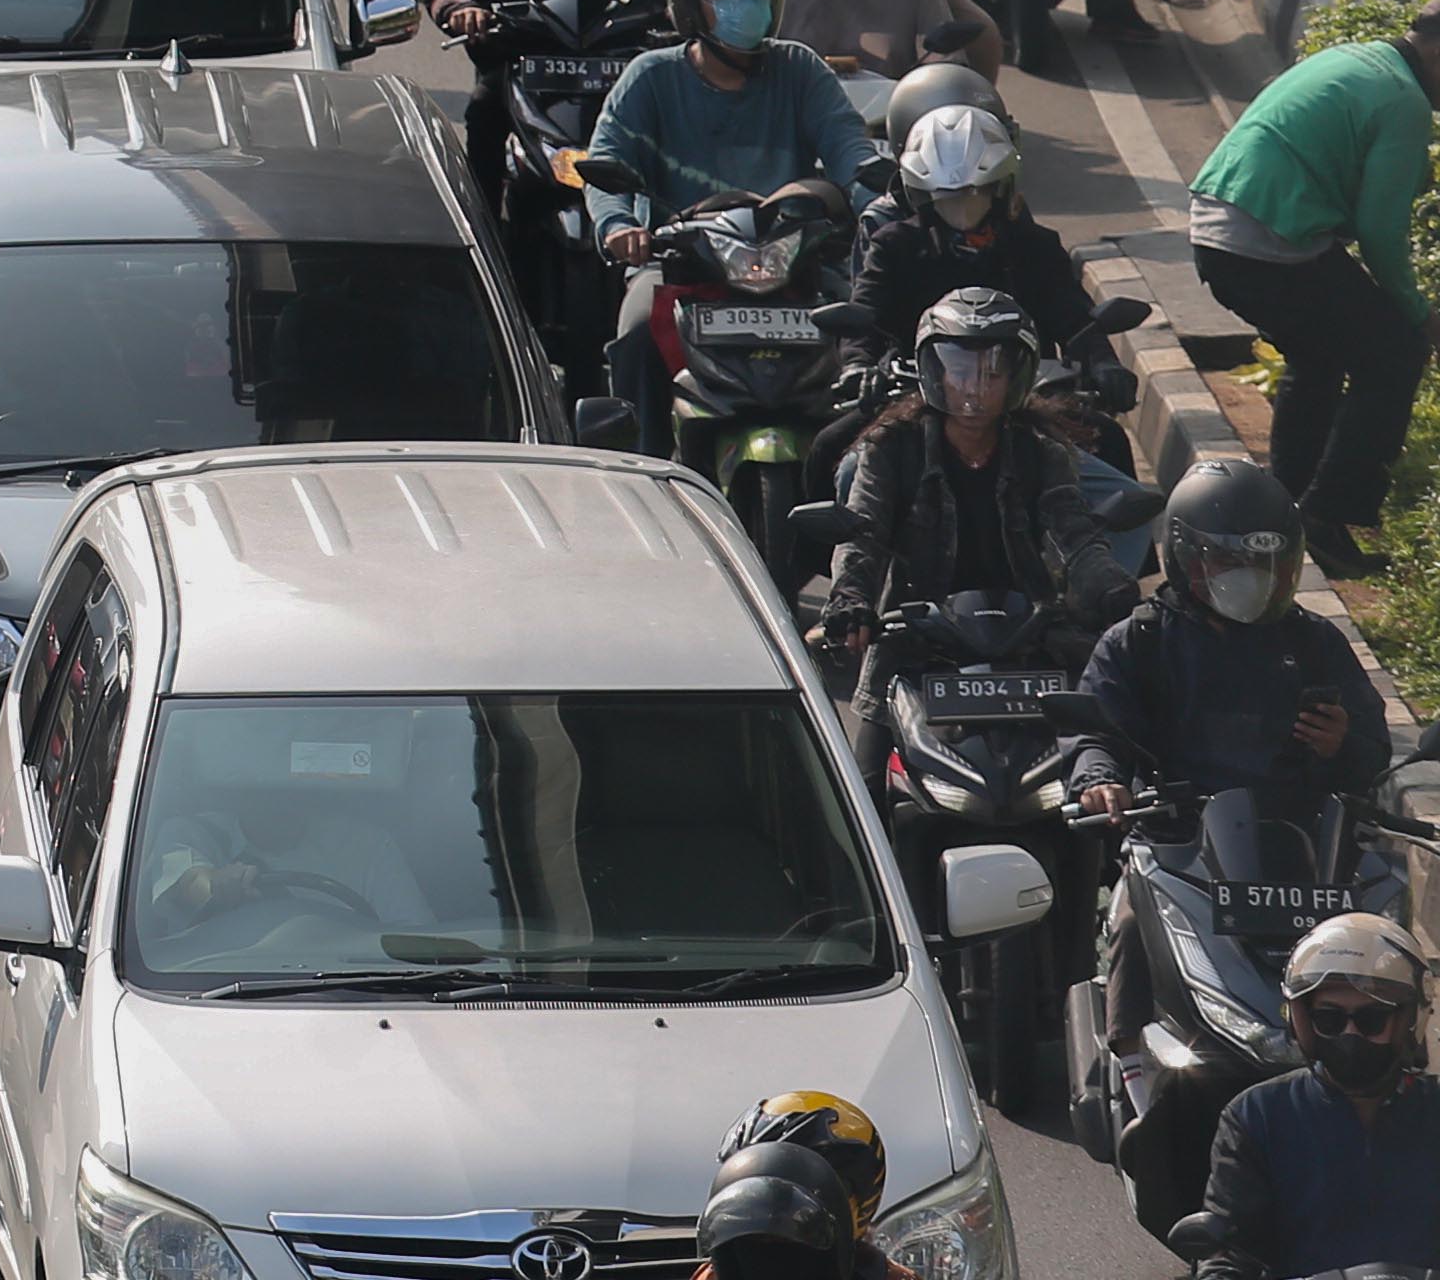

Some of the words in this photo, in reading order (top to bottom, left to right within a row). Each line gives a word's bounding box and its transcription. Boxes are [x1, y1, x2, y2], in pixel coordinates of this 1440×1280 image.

[526, 60, 536, 74] B
[546, 60, 588, 75] 3334
[703, 310, 714, 325] B
[727, 310, 772, 325] 3035
[935, 682, 946, 698] B
[958, 681, 1009, 696] 5034
[1219, 885, 1231, 905] B
[1248, 885, 1302, 907] 5710
[1313, 887, 1354, 910] FFA
